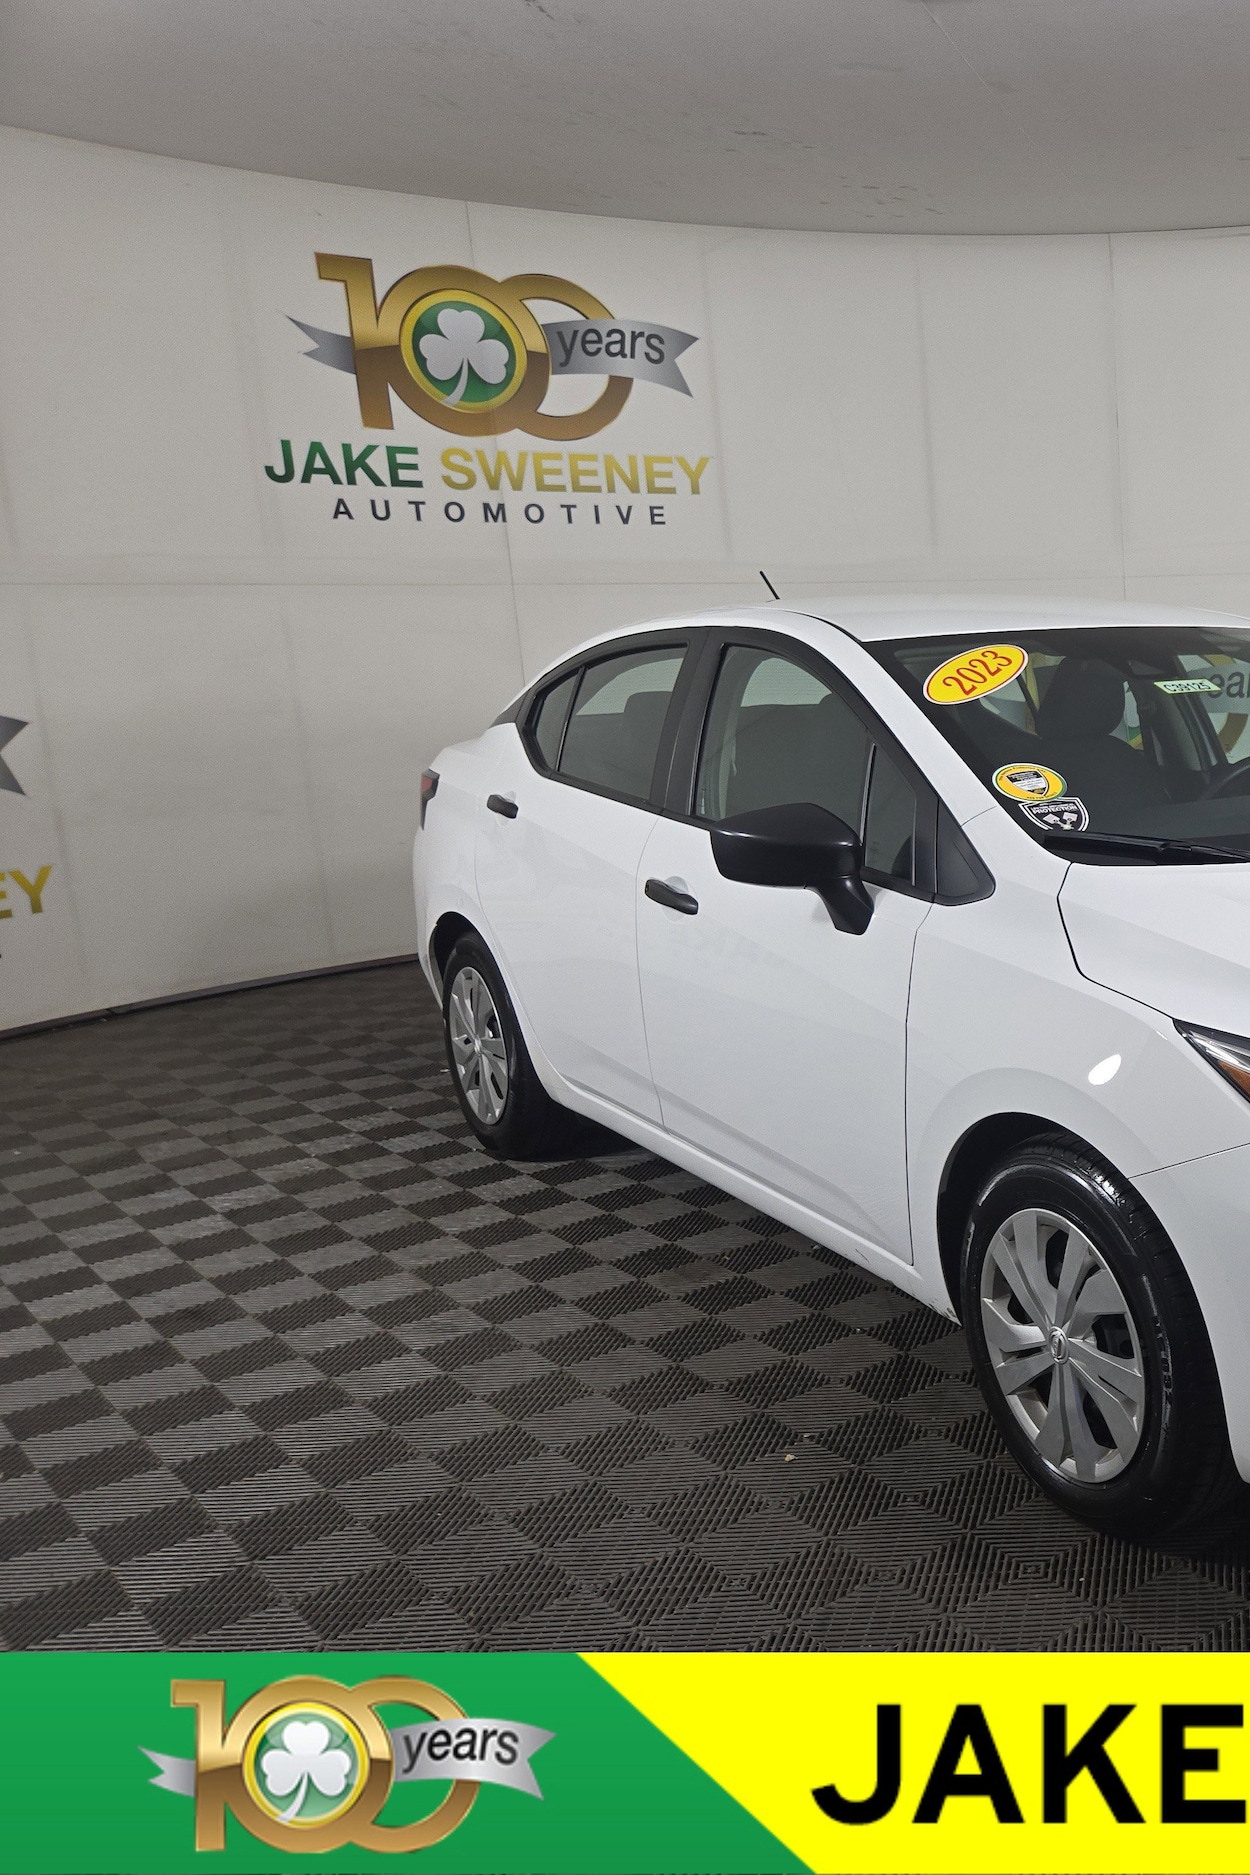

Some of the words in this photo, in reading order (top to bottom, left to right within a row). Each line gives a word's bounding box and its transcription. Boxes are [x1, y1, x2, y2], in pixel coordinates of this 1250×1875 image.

[556, 328, 666, 367] years
[264, 439, 424, 489] JAKE
[440, 447, 711, 496] SWEENEY
[332, 498, 667, 526] AUTOMOTIVE
[942, 650, 1013, 696] 2023
